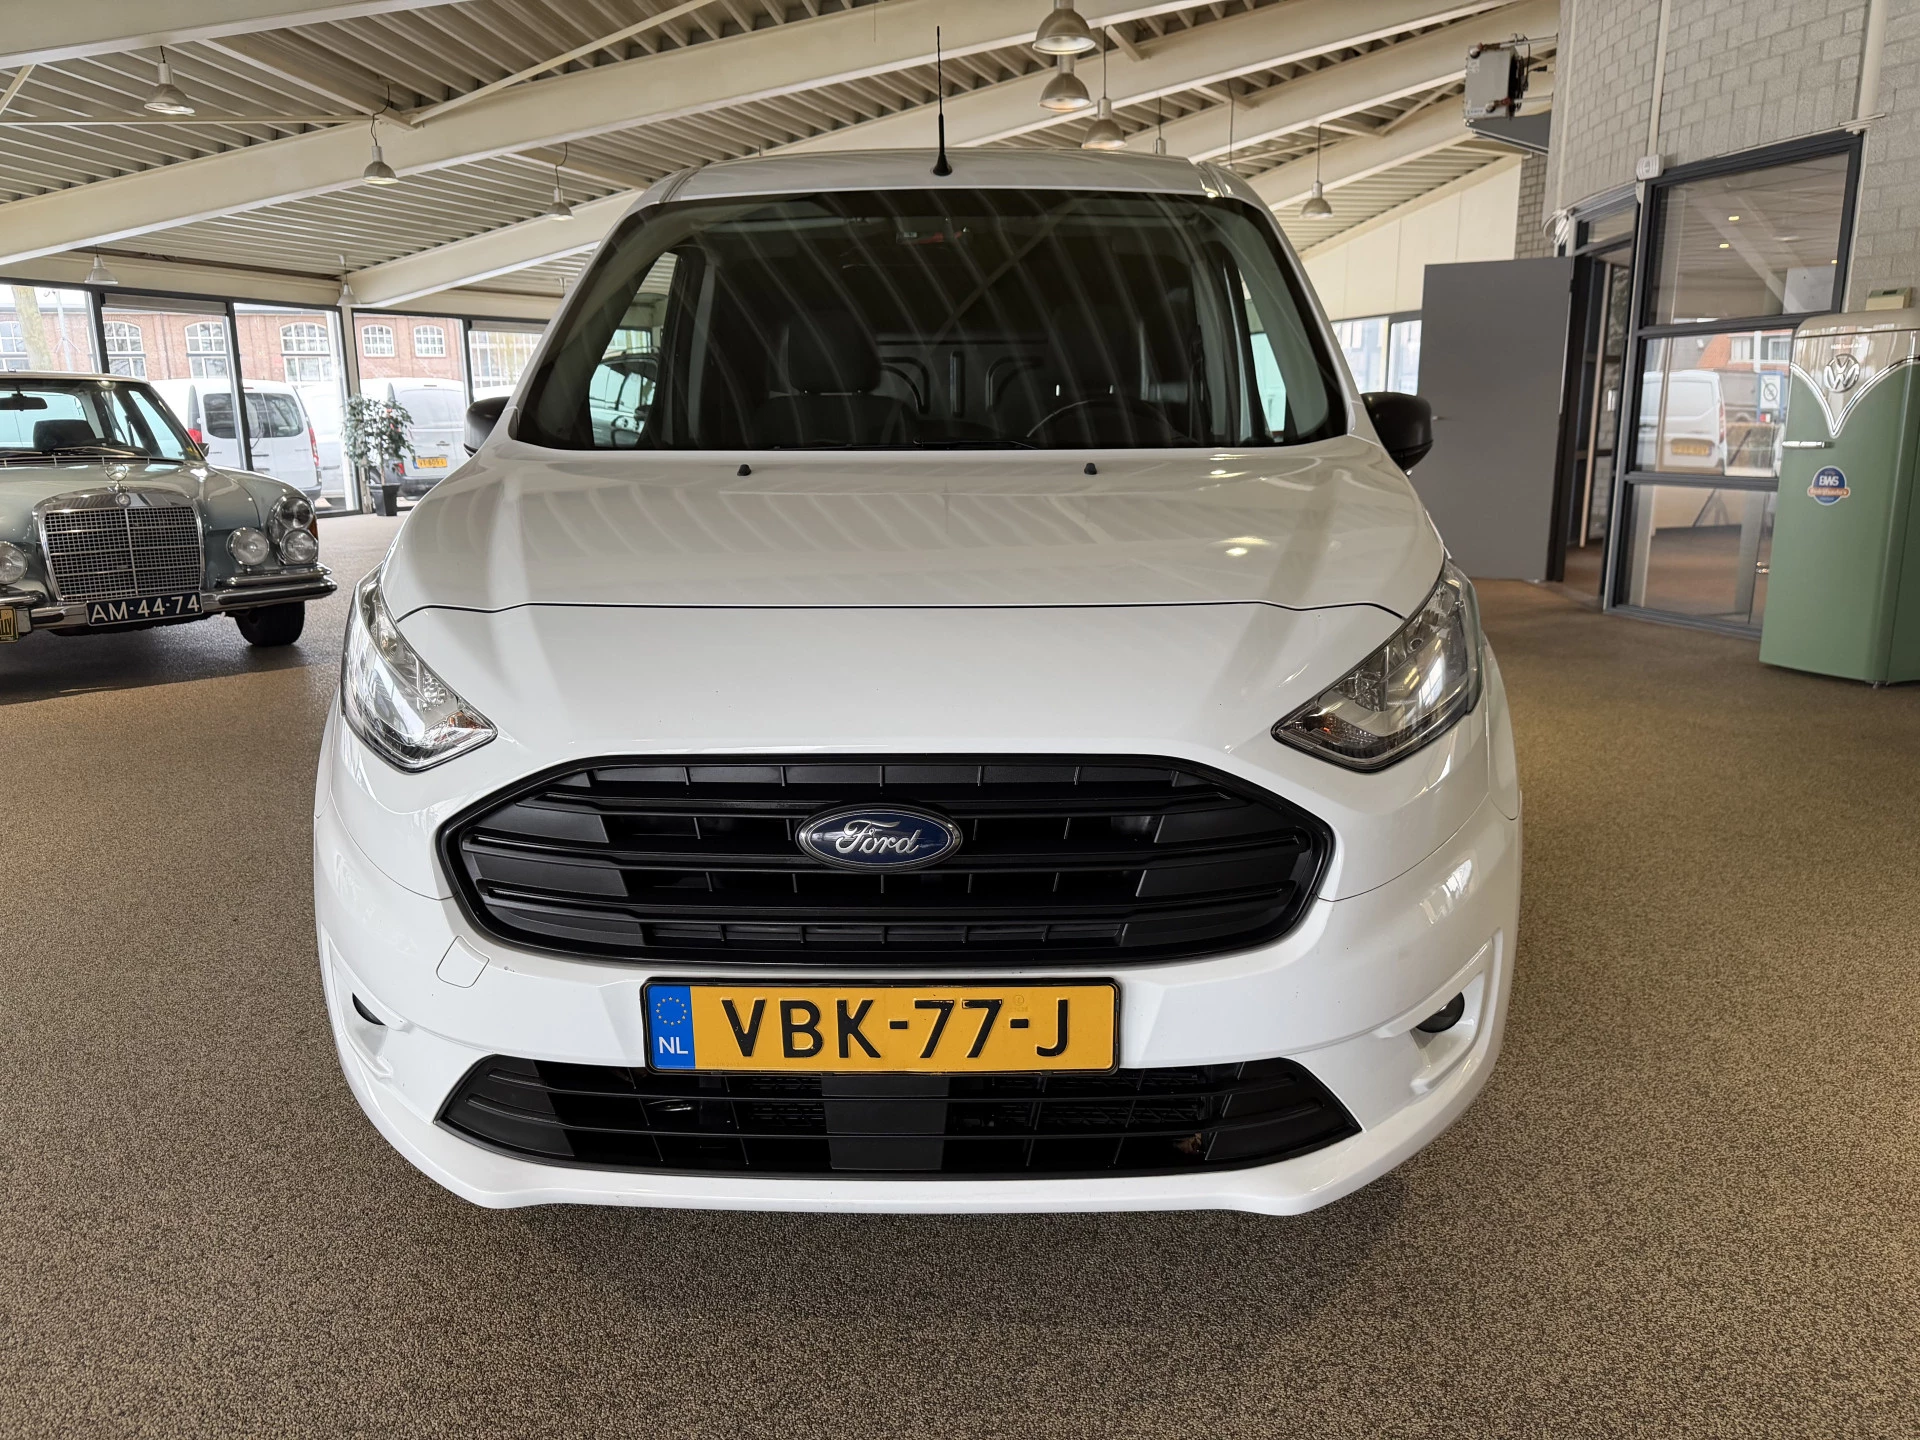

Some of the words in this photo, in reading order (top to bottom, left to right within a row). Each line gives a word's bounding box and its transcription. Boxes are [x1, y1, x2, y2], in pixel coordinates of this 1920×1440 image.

[91, 594, 200, 623] AM-44-74
[835, 819, 923, 854] Ford
[720, 998, 1069, 1059] VBK-77-J
[658, 1036, 689, 1055] NL
